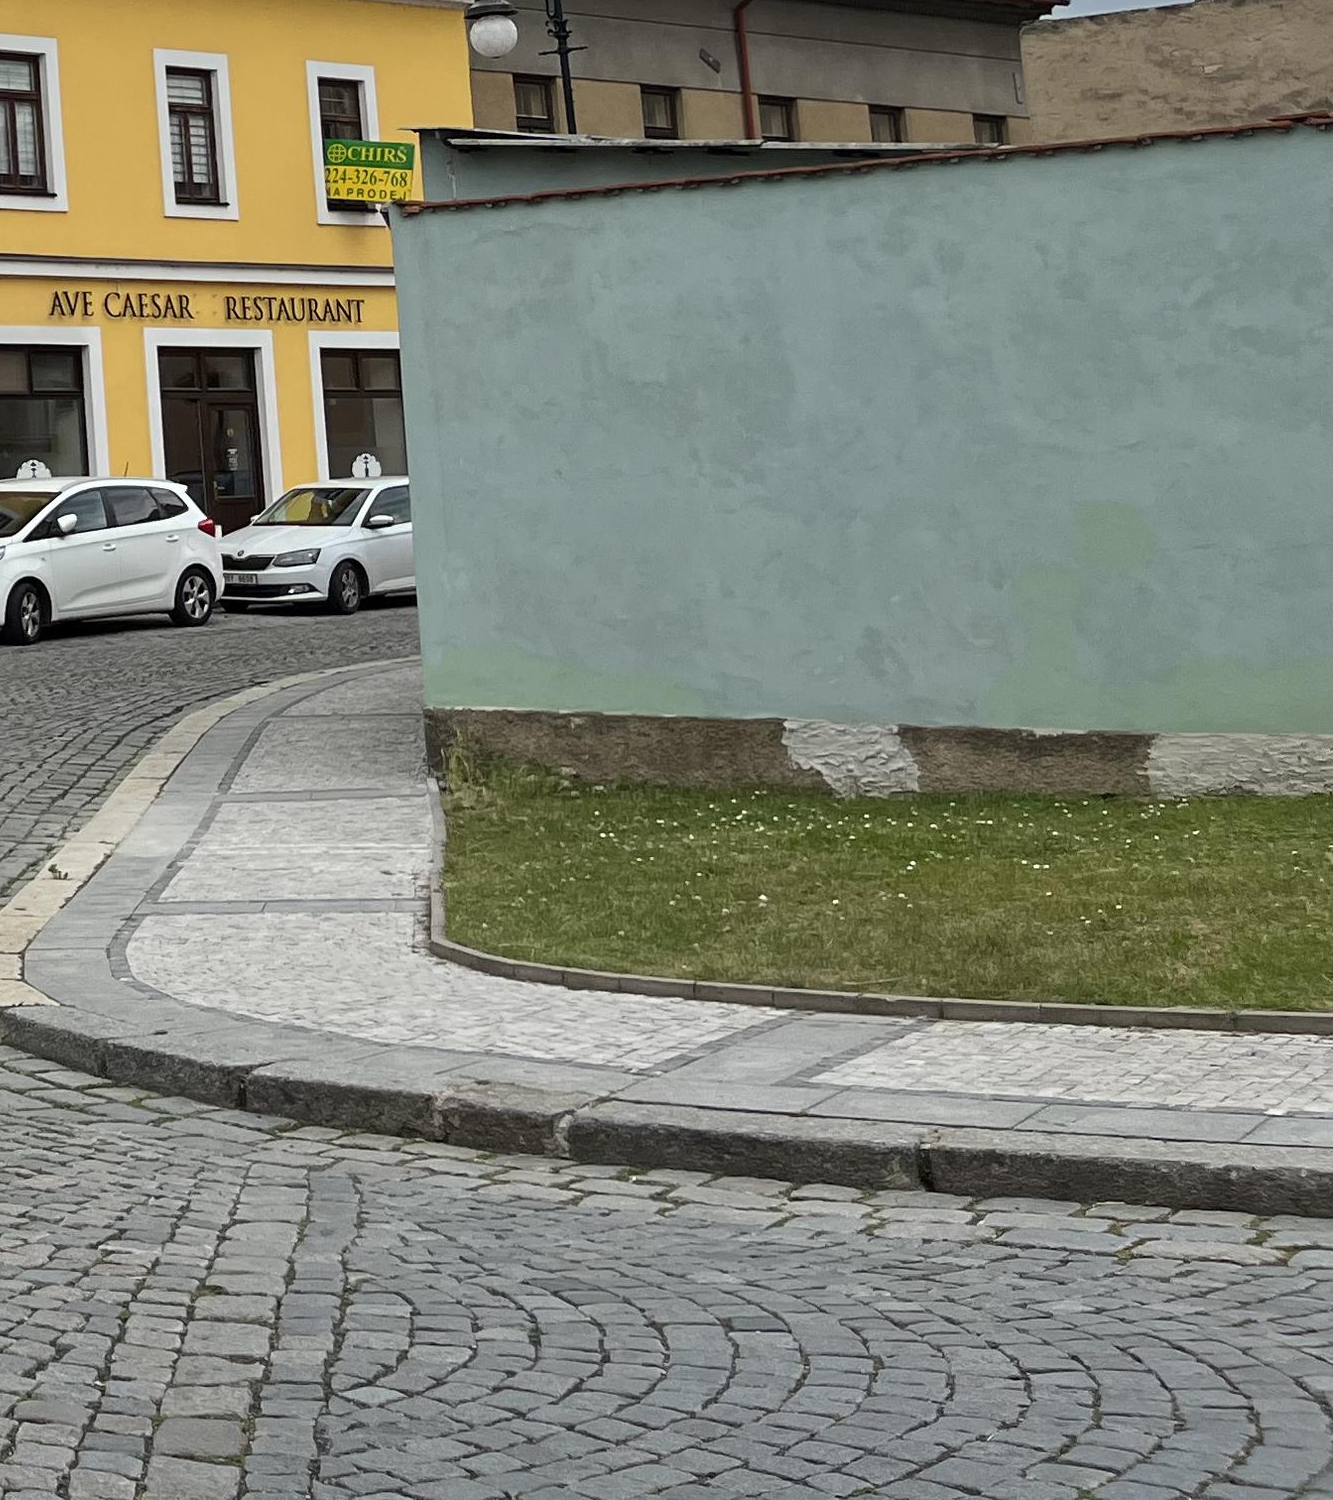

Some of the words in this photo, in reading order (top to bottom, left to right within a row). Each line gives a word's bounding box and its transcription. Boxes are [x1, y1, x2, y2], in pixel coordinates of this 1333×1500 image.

[49, 291, 95, 317] AVE
[104, 292, 194, 319] CAESAR
[225, 296, 365, 323] RESTAURANT
